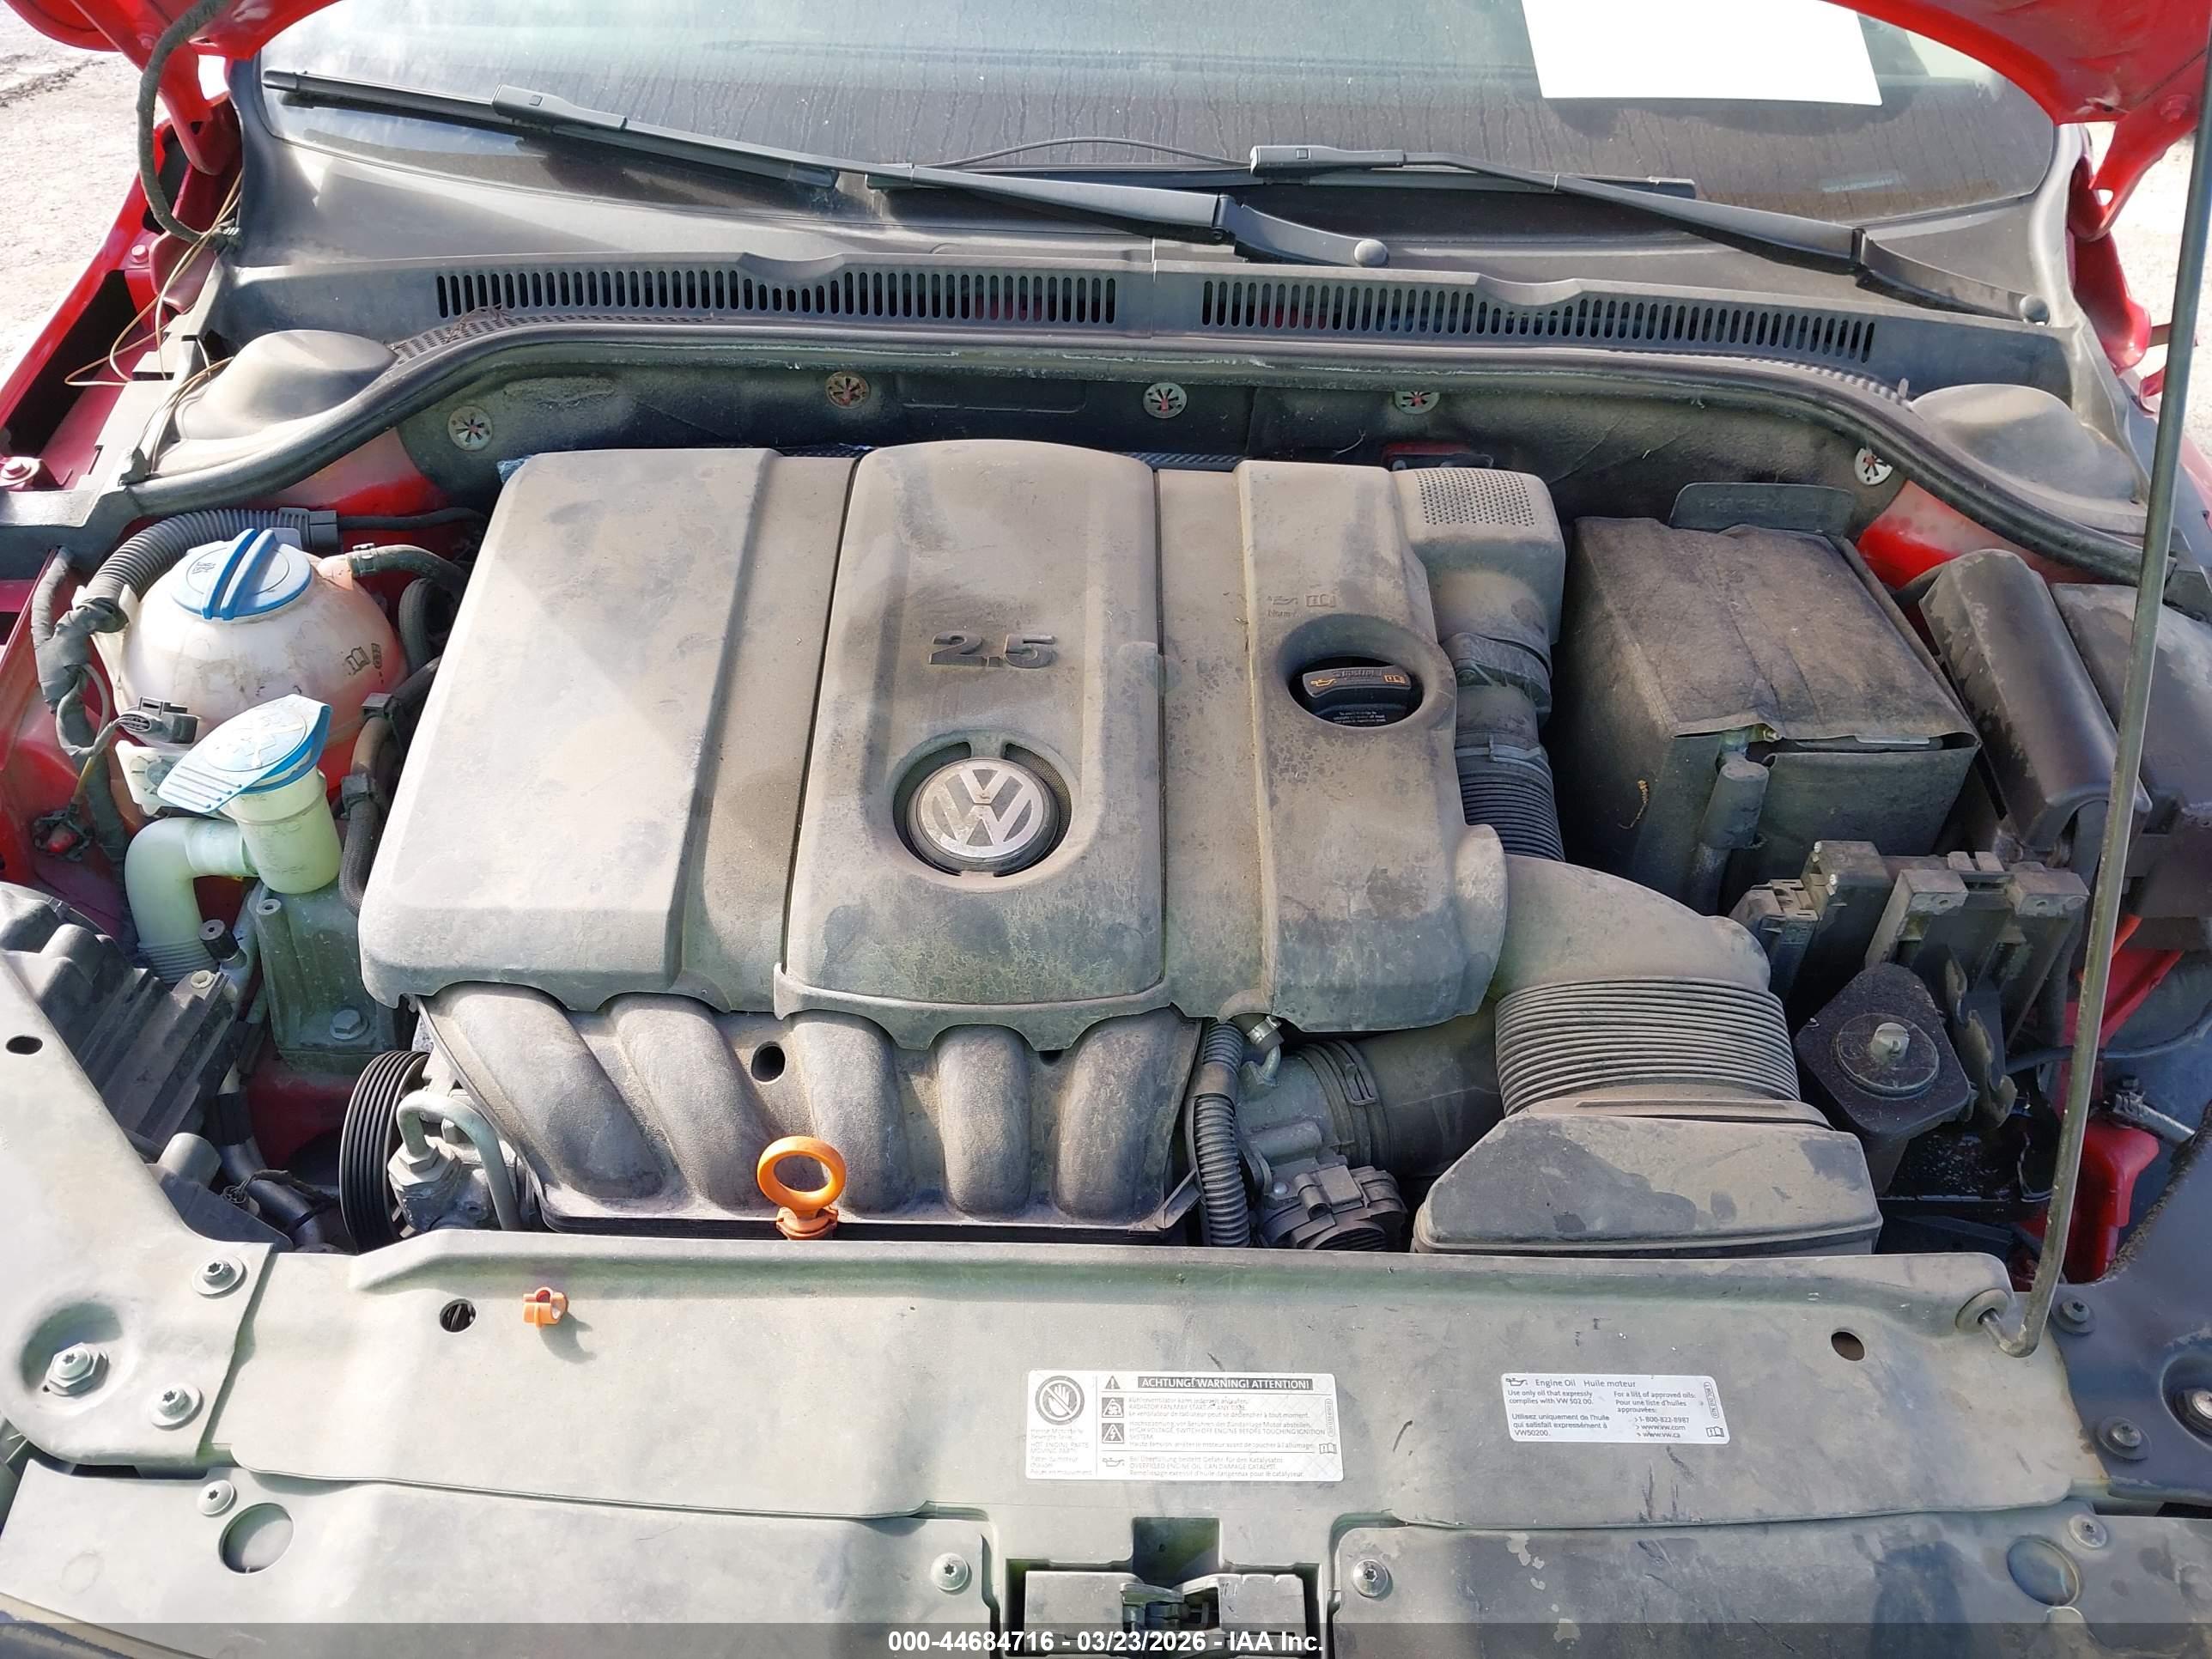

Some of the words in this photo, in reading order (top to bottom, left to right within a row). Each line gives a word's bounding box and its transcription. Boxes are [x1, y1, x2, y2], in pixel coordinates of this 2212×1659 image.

[928, 629, 1058, 670] 2.5
[1197, 1378, 1249, 1389] WARNING!
[1251, 1379, 1310, 1389] ATTENTION!
[1535, 1379, 1563, 1388] Engine
[1562, 1390, 1593, 1399] expressly
[1538, 1413, 1579, 1422] uniquement
[1553, 1421, 1602, 1430] expressément
